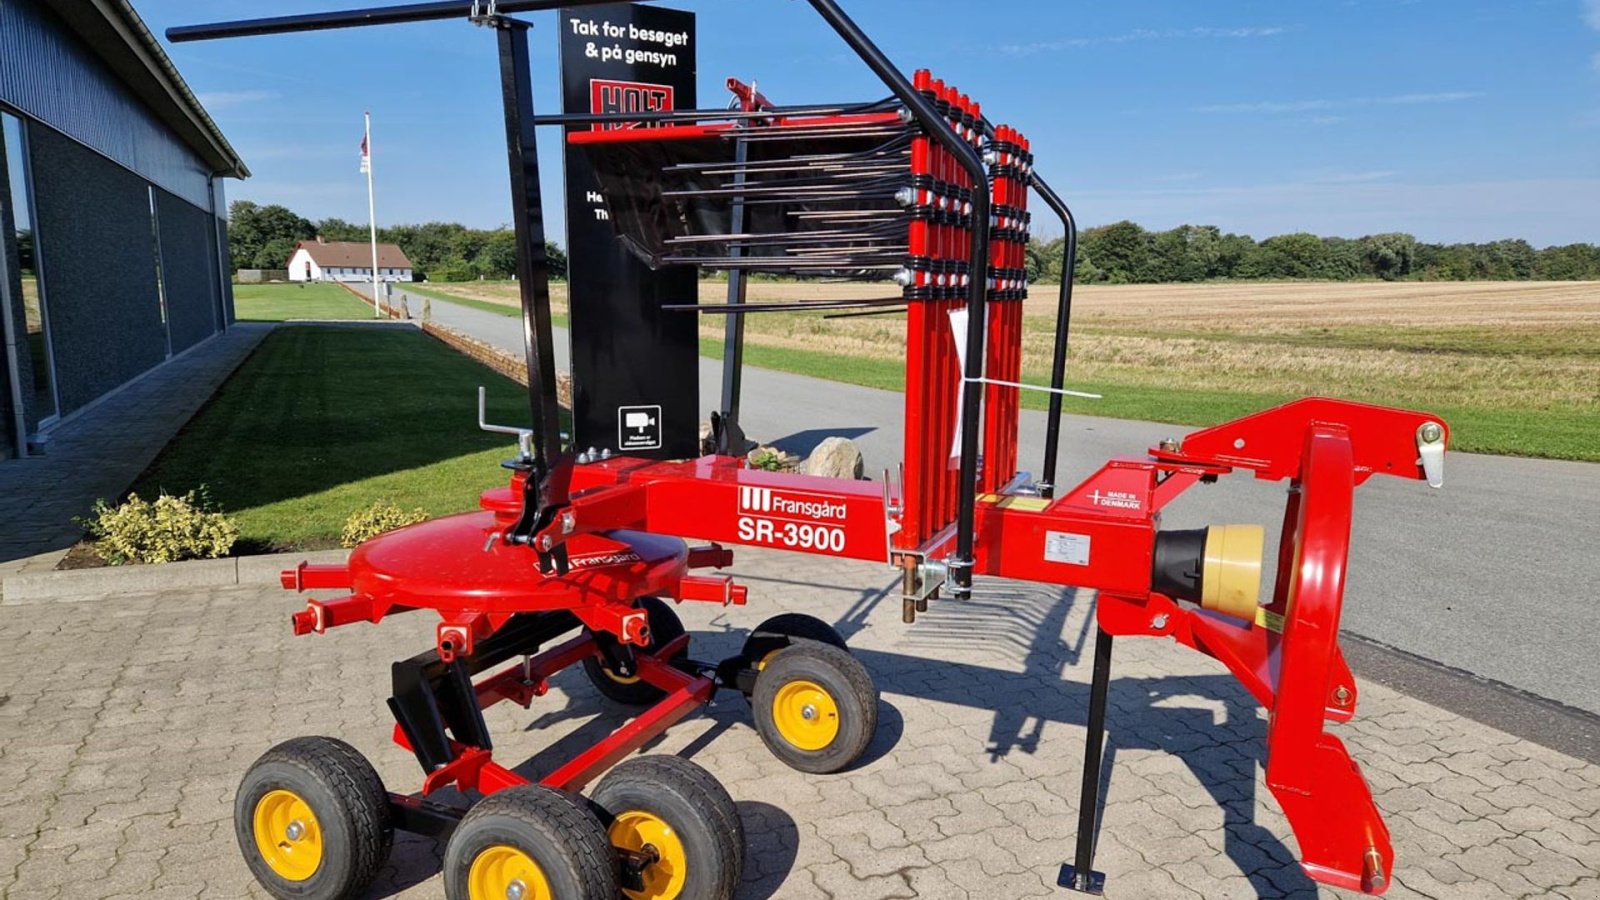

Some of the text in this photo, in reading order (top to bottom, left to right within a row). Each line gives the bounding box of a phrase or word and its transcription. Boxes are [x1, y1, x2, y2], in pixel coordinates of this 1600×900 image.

[570, 18, 688, 46] Tak for besøget
[585, 42, 677, 67] & på gensyn
[601, 85, 667, 125] HOLT
[773, 496, 847, 519] Fransgård
[1100, 499, 1140, 510] DENMARK
[1107, 491, 1127, 499] MADE
[738, 517, 846, 552] SR-3900
